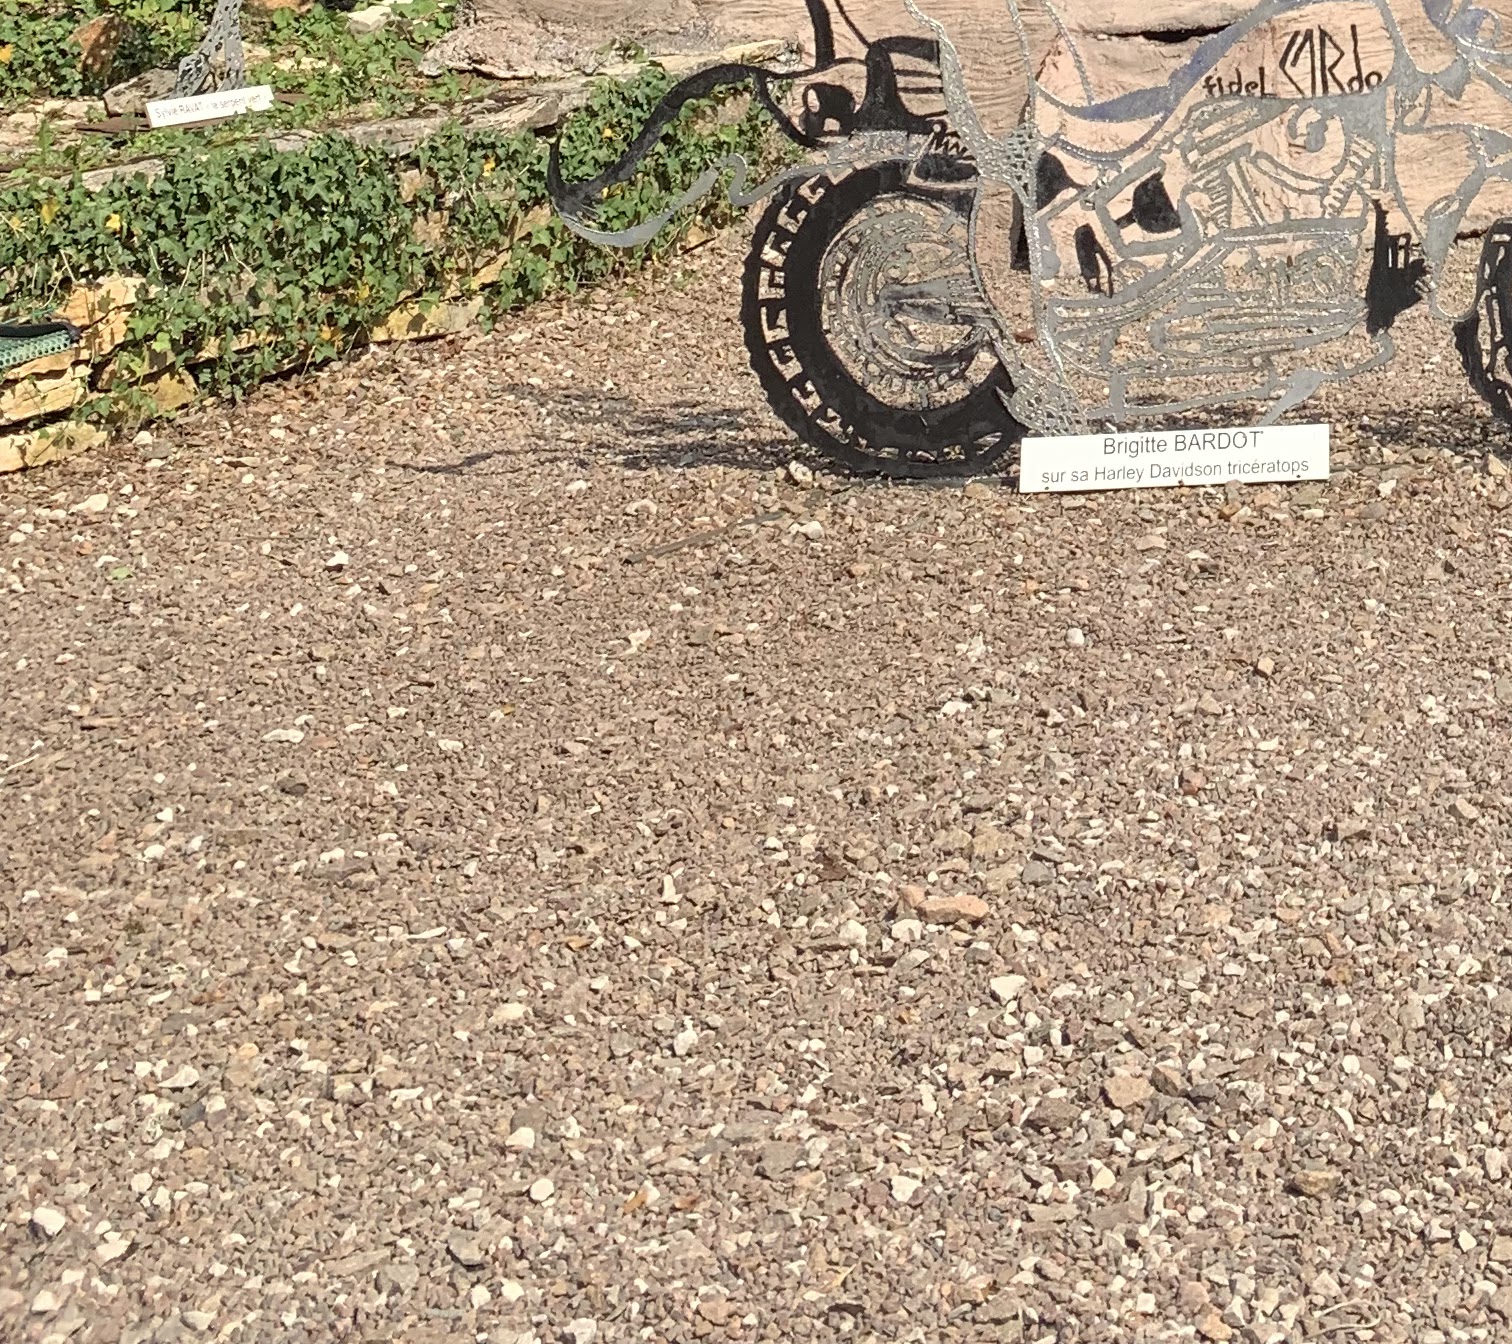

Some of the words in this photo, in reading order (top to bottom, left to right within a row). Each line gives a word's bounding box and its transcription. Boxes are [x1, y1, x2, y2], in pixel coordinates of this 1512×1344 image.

[1103, 435, 1168, 458] Brigitte
[1173, 430, 1263, 452] BARDOT
[1041, 470, 1066, 484] sur
[1070, 468, 1089, 482] sa
[1094, 465, 1144, 483] Harley
[1149, 462, 1223, 480] Davidson
[1227, 458, 1310, 477] tricératops
